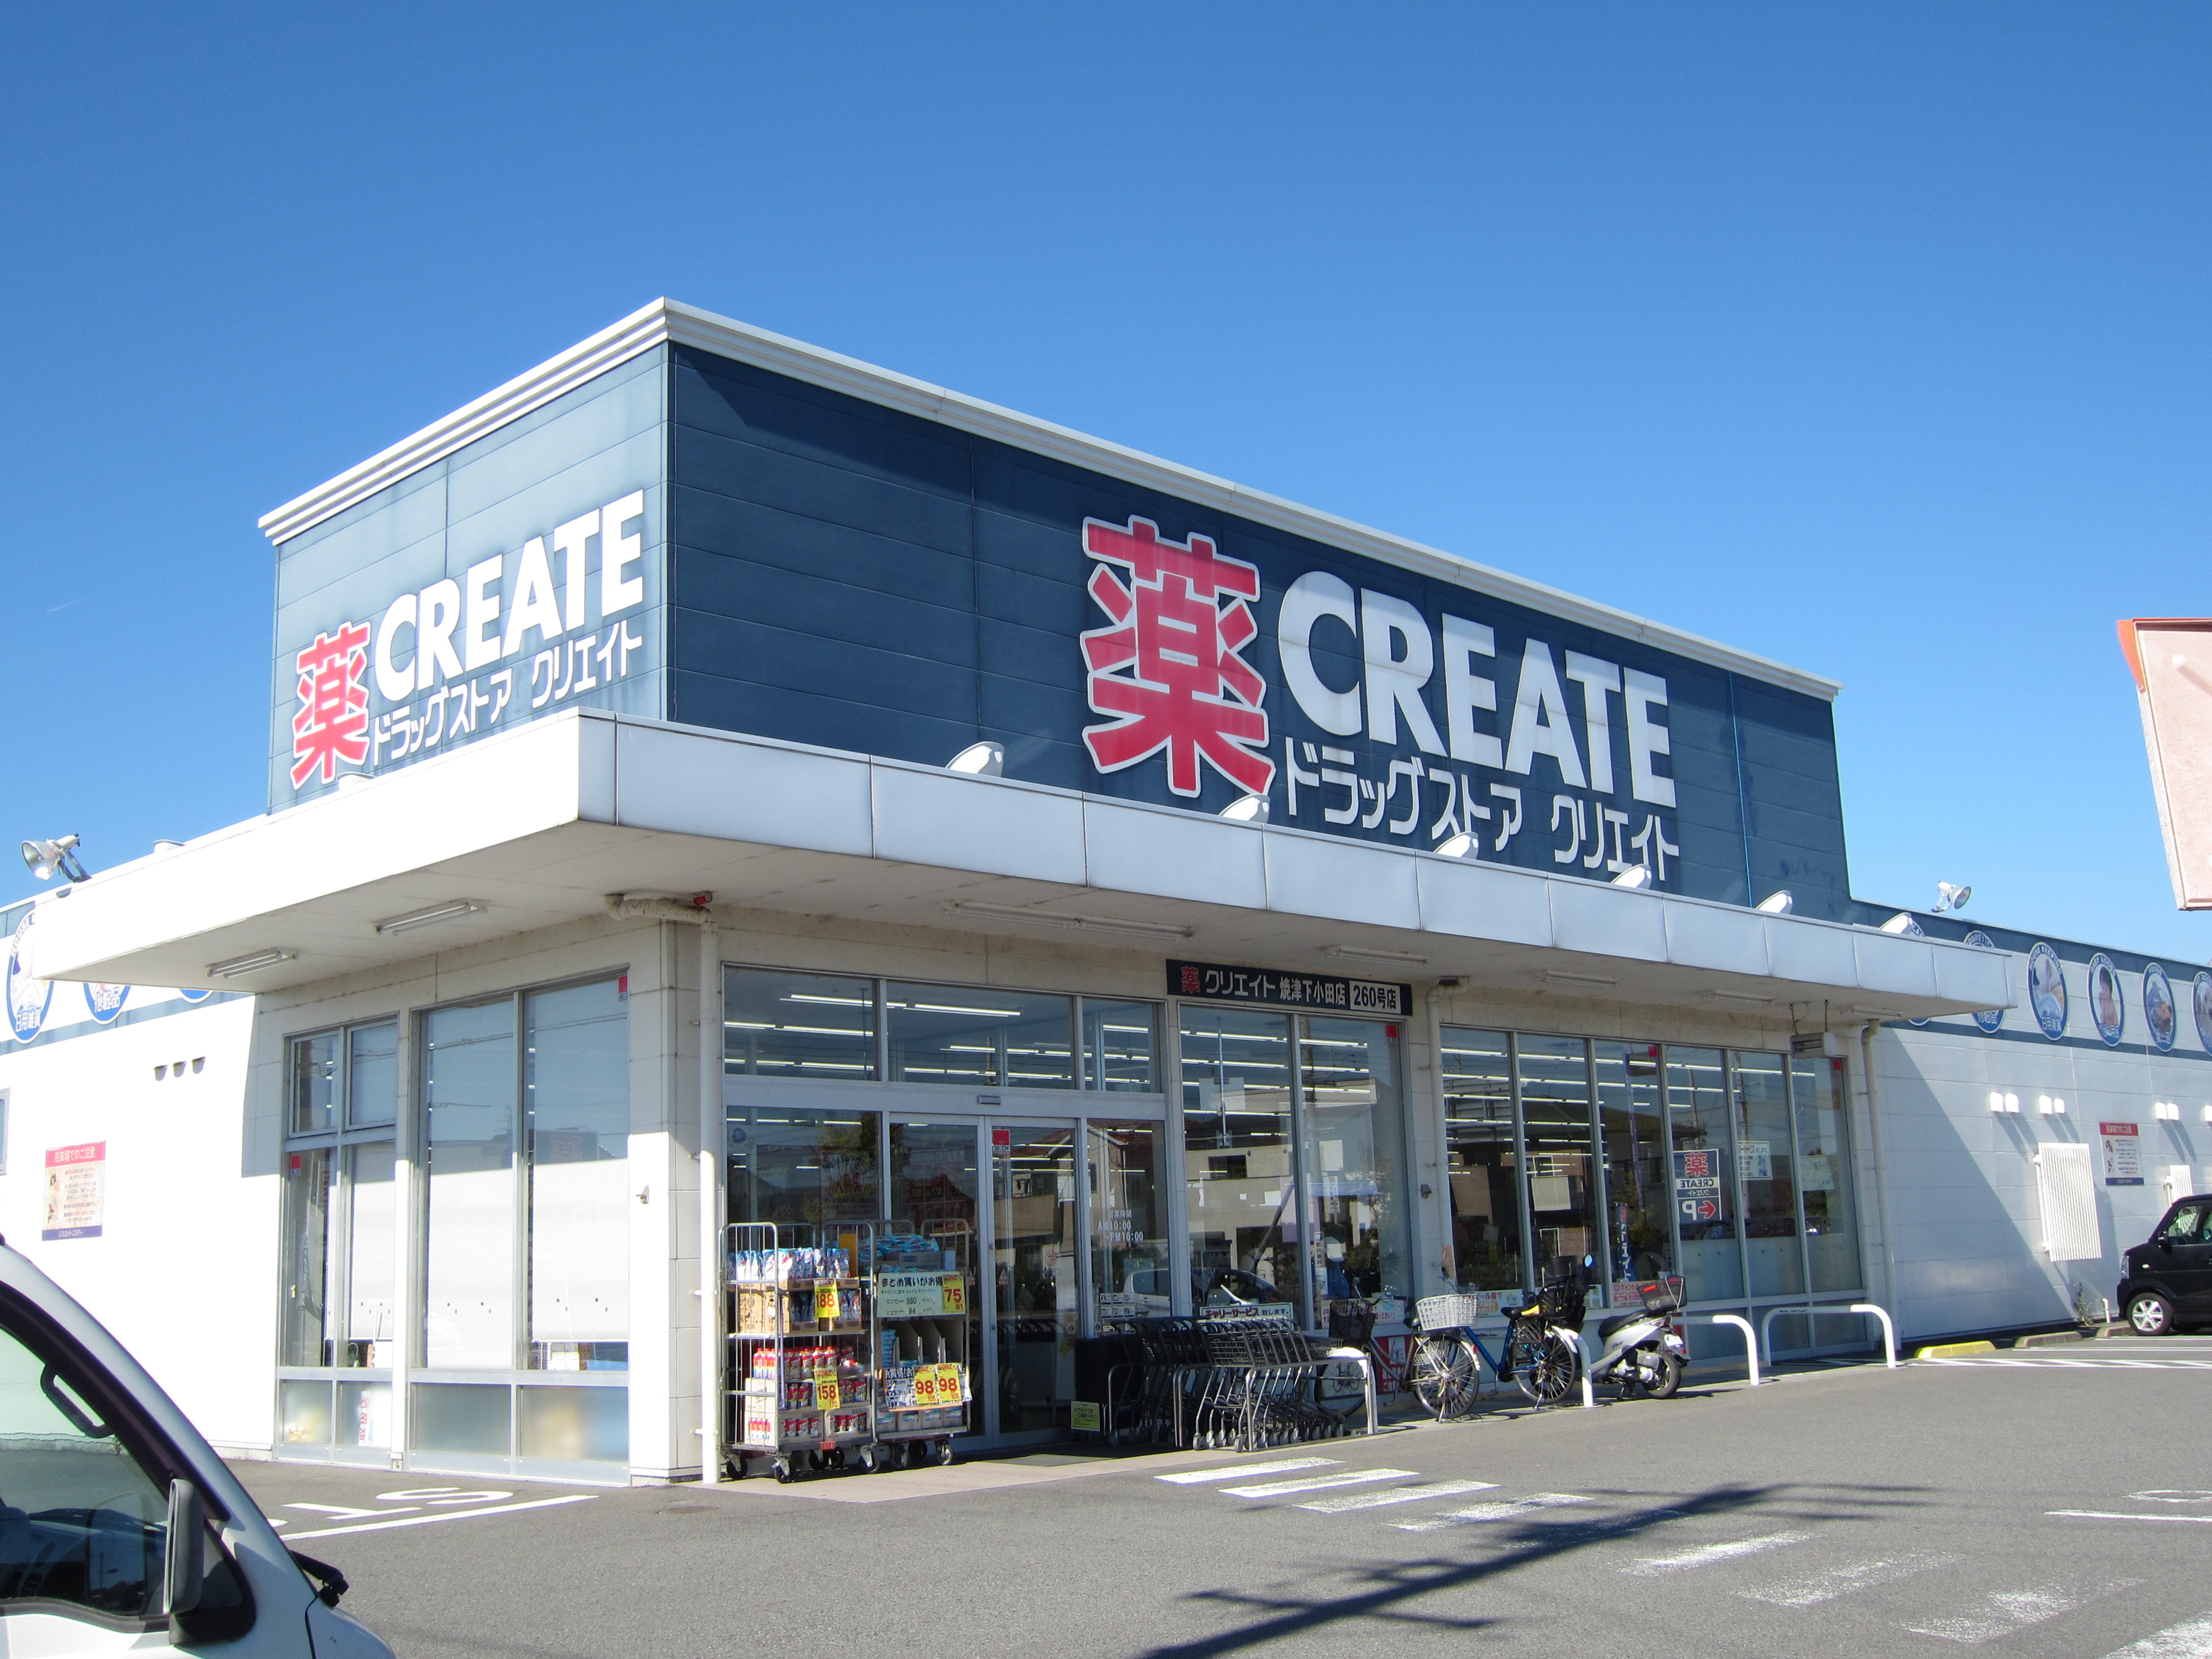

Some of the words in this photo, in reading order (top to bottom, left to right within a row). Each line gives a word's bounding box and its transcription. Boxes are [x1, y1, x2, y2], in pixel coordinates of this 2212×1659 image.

[290, 621, 371, 789] 薬
[374, 489, 643, 701] CREATE
[1079, 514, 1276, 798] 薬
[1279, 571, 1676, 808] CREATE
[373, 668, 512, 766] ドラッグストア
[531, 620, 643, 708] クリエイト
[1286, 737, 1522, 852] ドラッグストア
[1551, 794, 1679, 881] クリエイト
[1181, 966, 1201, 994] 薬
[1204, 969, 1276, 998] クリエイト
[1353, 984, 1397, 1010] 260号店
[816, 1293, 835, 1308] 188
[944, 1288, 962, 1302] 75
[1205, 1307, 1260, 1319] キャリーサービス
[817, 1384, 837, 1400] 158
[915, 1380, 934, 1395] 98
[938, 1377, 957, 1392] 98
